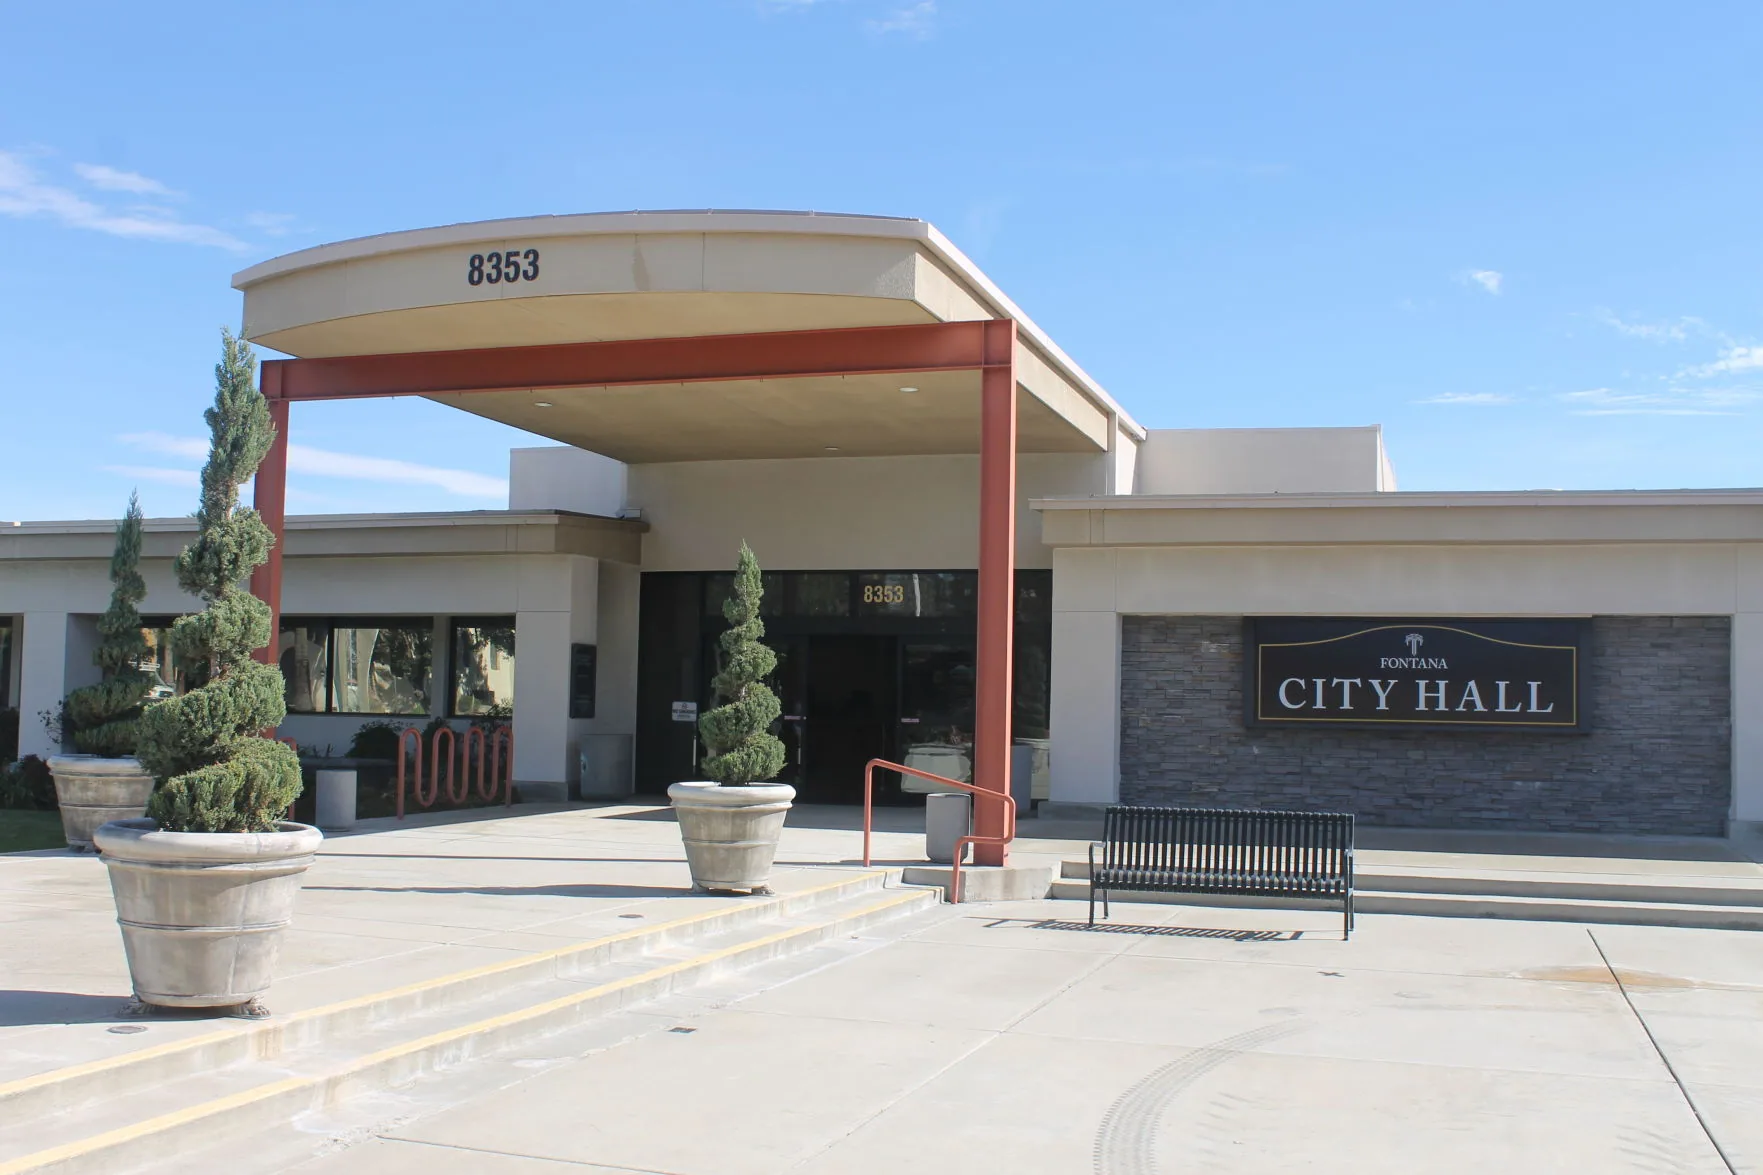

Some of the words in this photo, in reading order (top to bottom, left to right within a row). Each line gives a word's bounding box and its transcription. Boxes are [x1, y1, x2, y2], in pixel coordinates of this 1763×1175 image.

[468, 248, 540, 286] 8353
[863, 585, 904, 603] 8353
[1380, 657, 1448, 669] FONTANA
[1278, 677, 1398, 710] CITY
[1415, 679, 1554, 713] HALL
